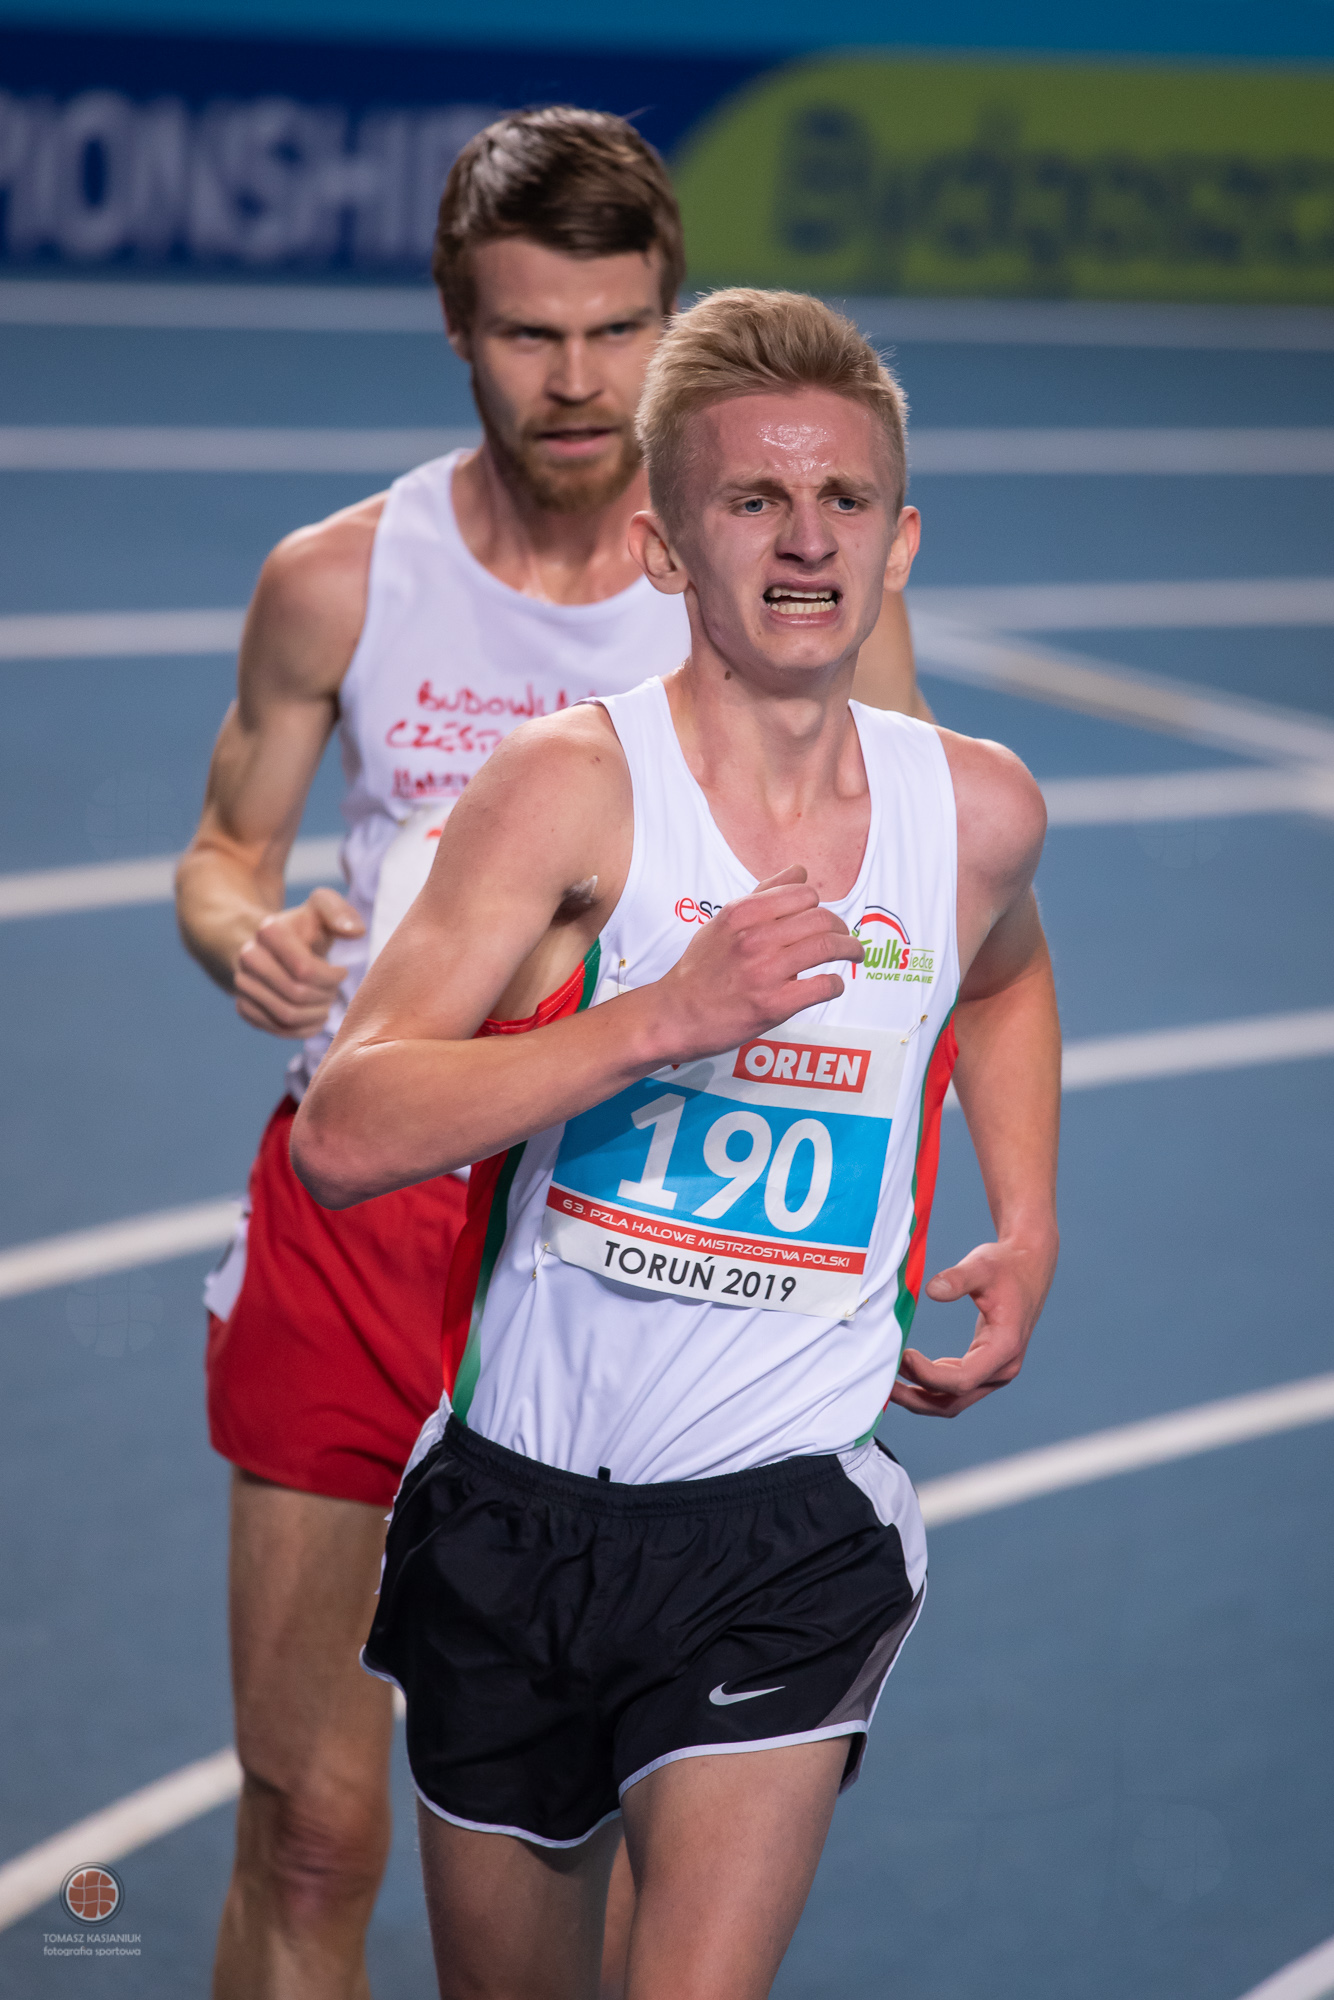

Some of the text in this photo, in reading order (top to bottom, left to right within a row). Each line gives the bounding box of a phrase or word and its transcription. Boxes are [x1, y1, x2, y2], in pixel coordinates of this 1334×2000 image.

[866, 972, 901, 982] NOWE
[745, 1045, 862, 1086] ORLEN
[616, 1092, 833, 1232] 190
[562, 1199, 850, 1268] 63. PZLA HALOWE MISTRZOSTWA POLSKI
[604, 1240, 797, 1302] TORUŃ 2019
